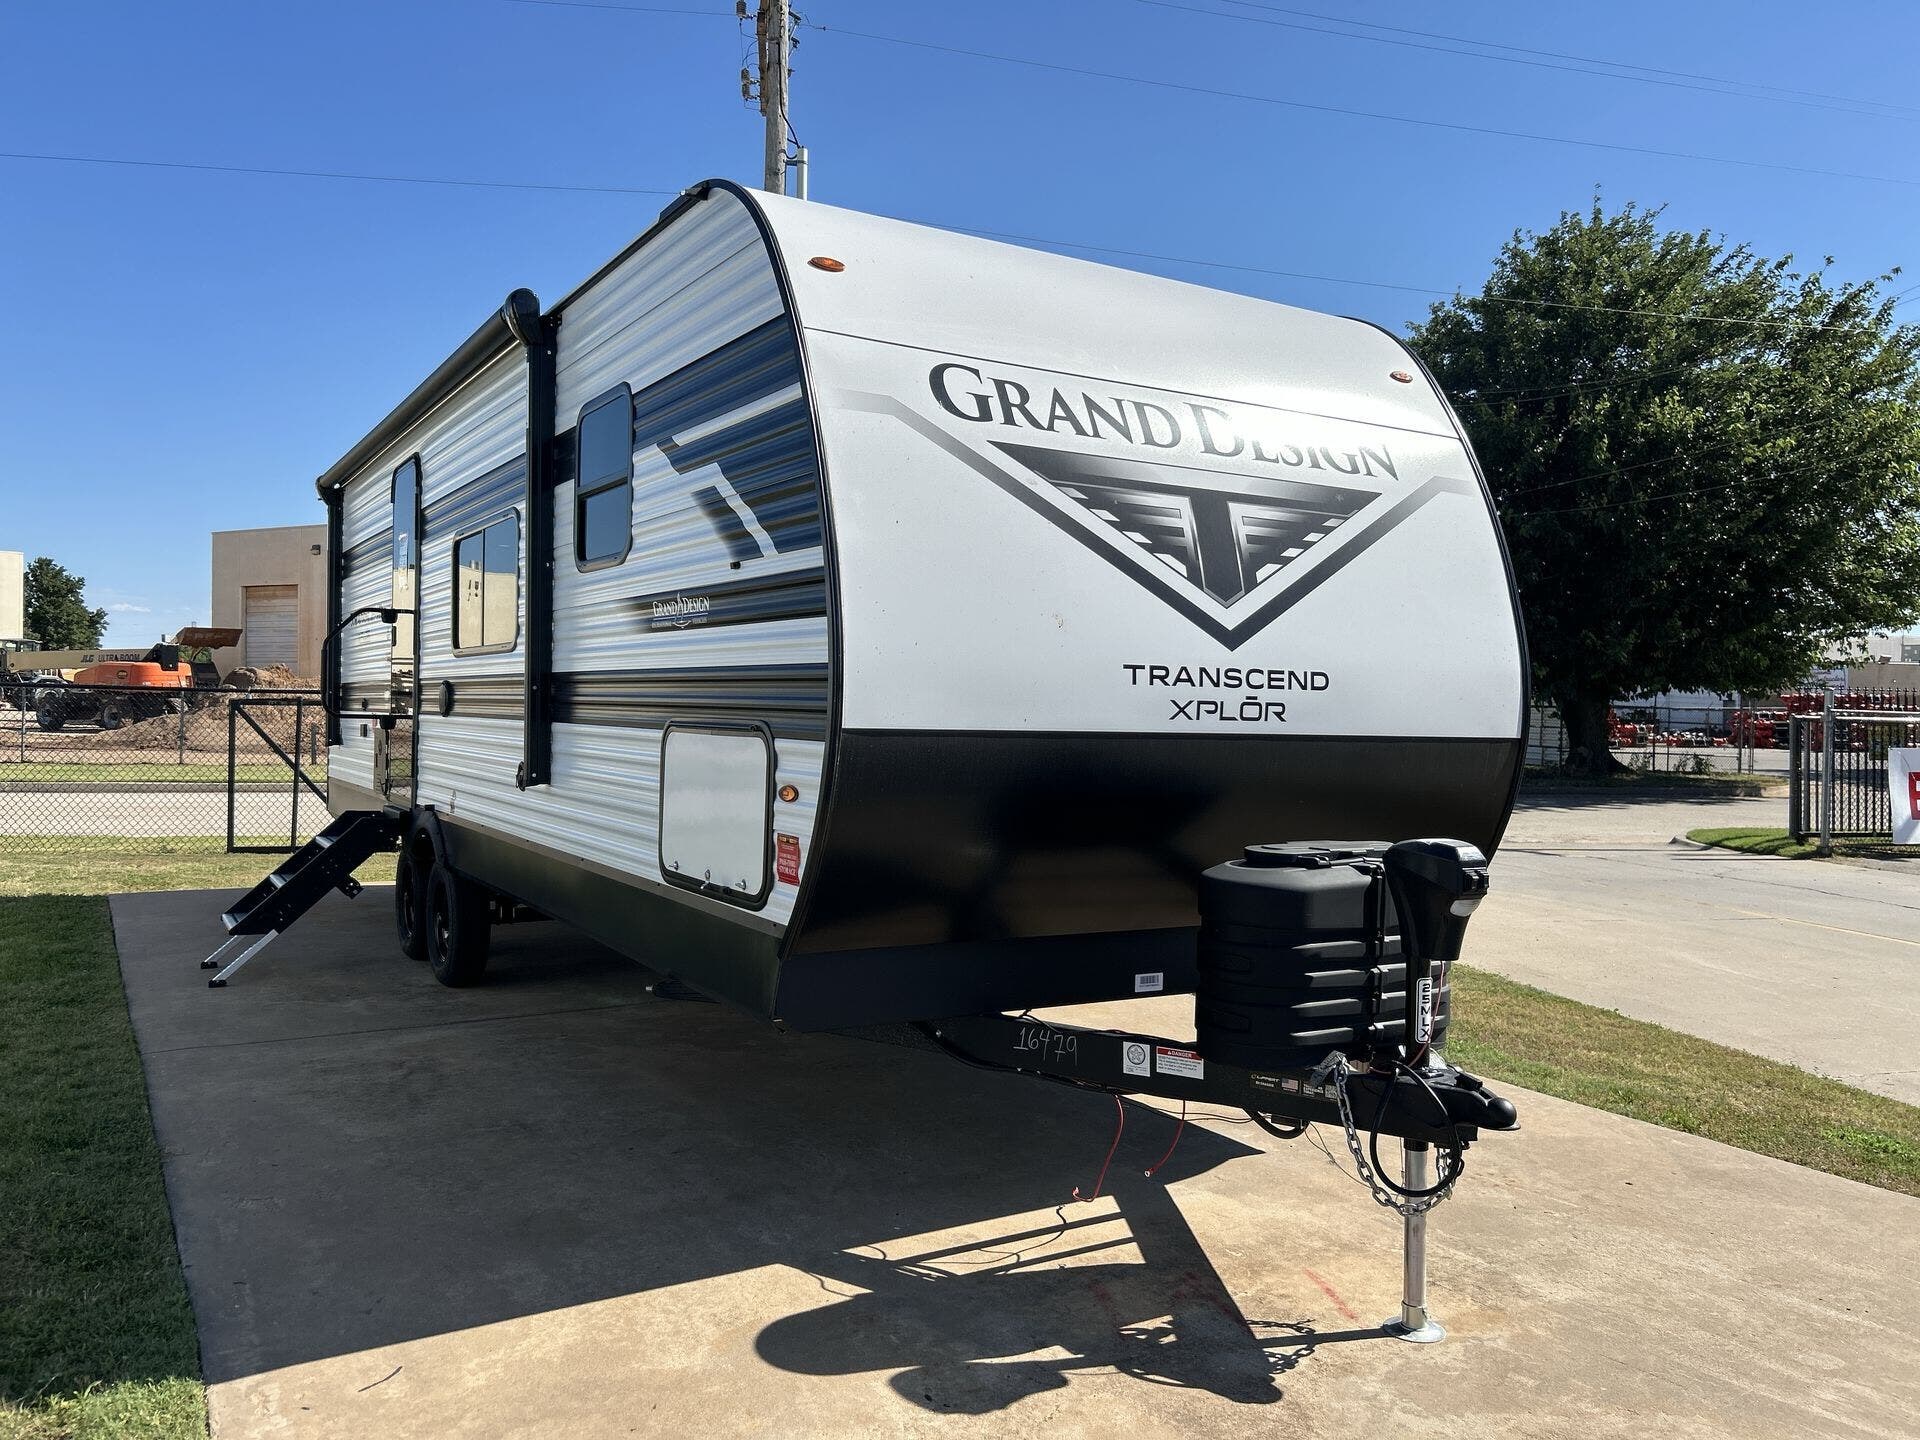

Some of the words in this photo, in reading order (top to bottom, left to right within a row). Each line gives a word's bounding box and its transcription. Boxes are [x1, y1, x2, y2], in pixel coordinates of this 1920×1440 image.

[928, 362, 1182, 449] GRAND
[653, 600, 678, 616] GRAND
[682, 596, 710, 614] DESIGN
[1122, 664, 1330, 692] TRANSCEND
[1013, 1027, 1078, 1066] 16479
[1171, 1050, 1192, 1059] DANGER
